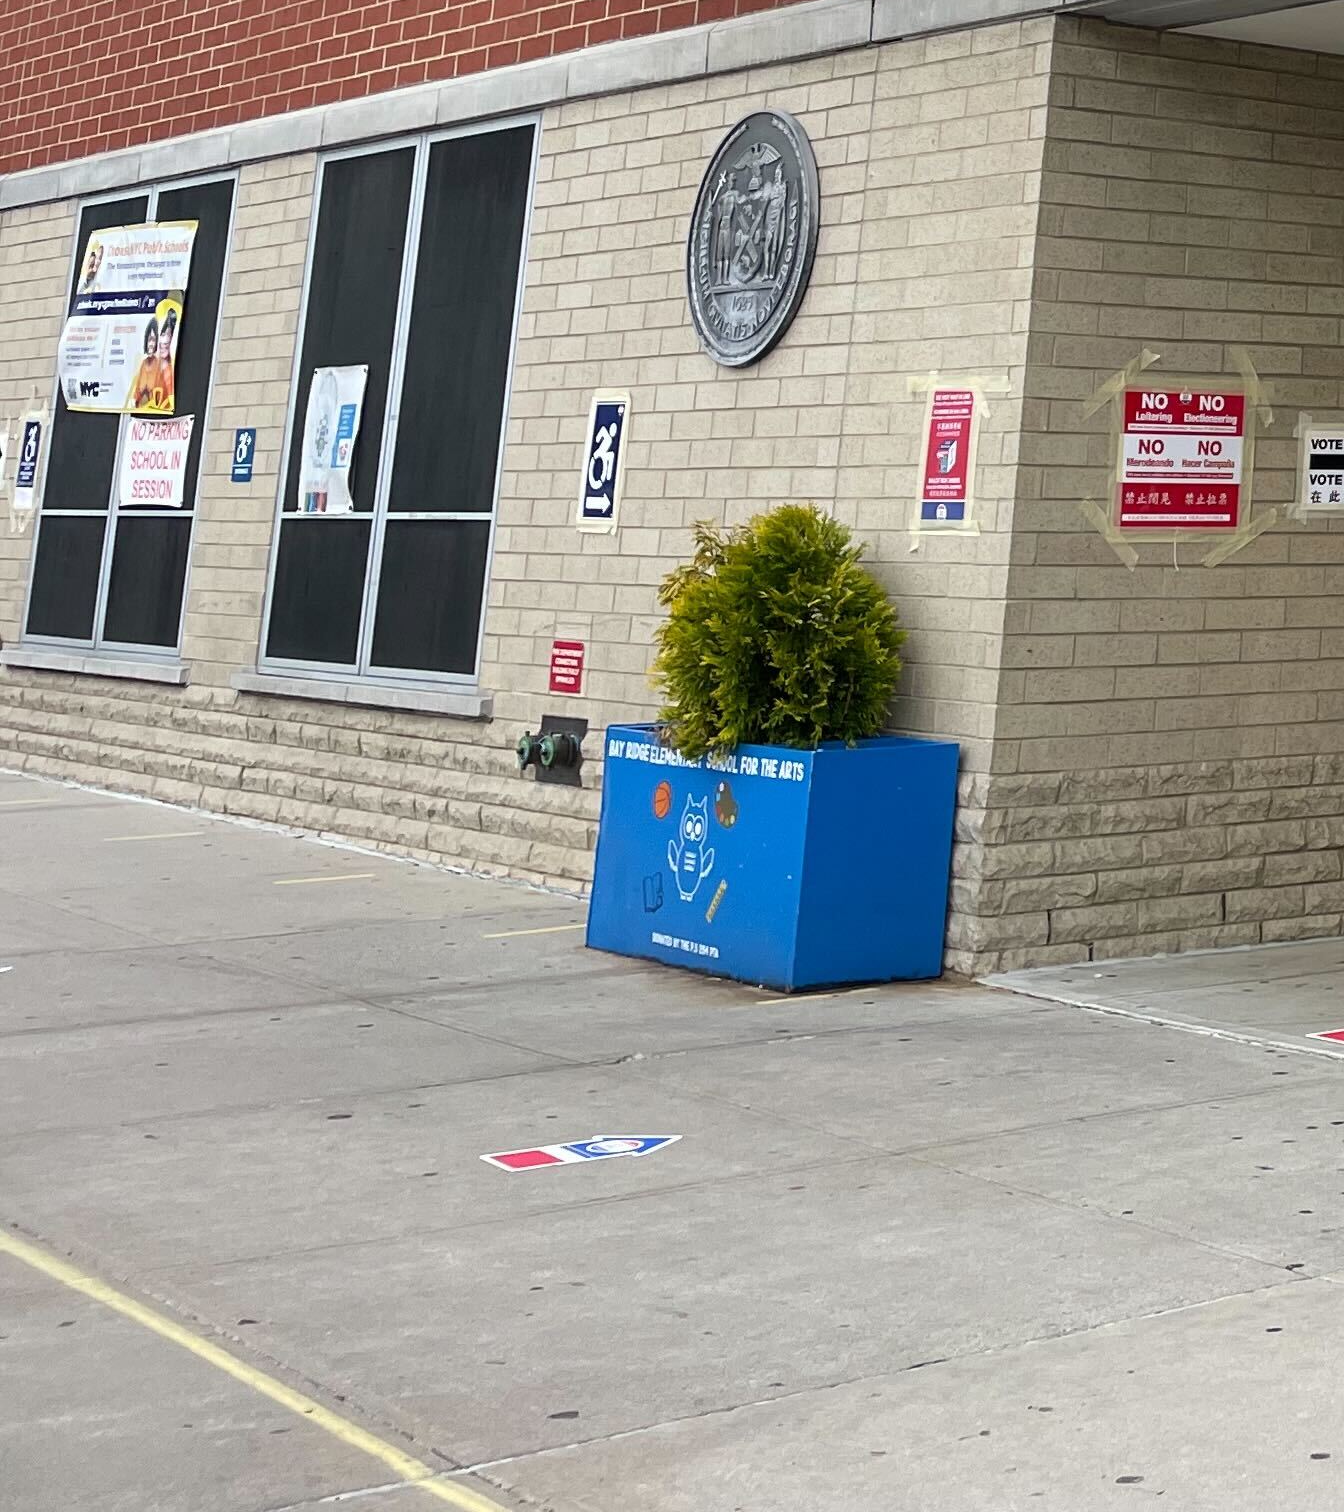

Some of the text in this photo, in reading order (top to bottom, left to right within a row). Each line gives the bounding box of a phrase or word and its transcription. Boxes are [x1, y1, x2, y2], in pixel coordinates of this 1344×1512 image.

[1141, 393, 1225, 411] NO NO
[1135, 411, 1237, 425] Loitering Electioneering
[132, 420, 189, 440] NO PARKING
[1138, 439, 1222, 456] NO NO
[1311, 439, 1343, 450] VOTE
[130, 450, 181, 470] SCHOOL IN
[1309, 474, 1342, 485] VOTE
[131, 479, 173, 499] SESSION
[608, 739, 624, 759] BAY
[626, 741, 650, 762] RIDGE
[740, 756, 758, 776] FOR
[760, 758, 778, 778] THE
[778, 760, 805, 781] ARTS
